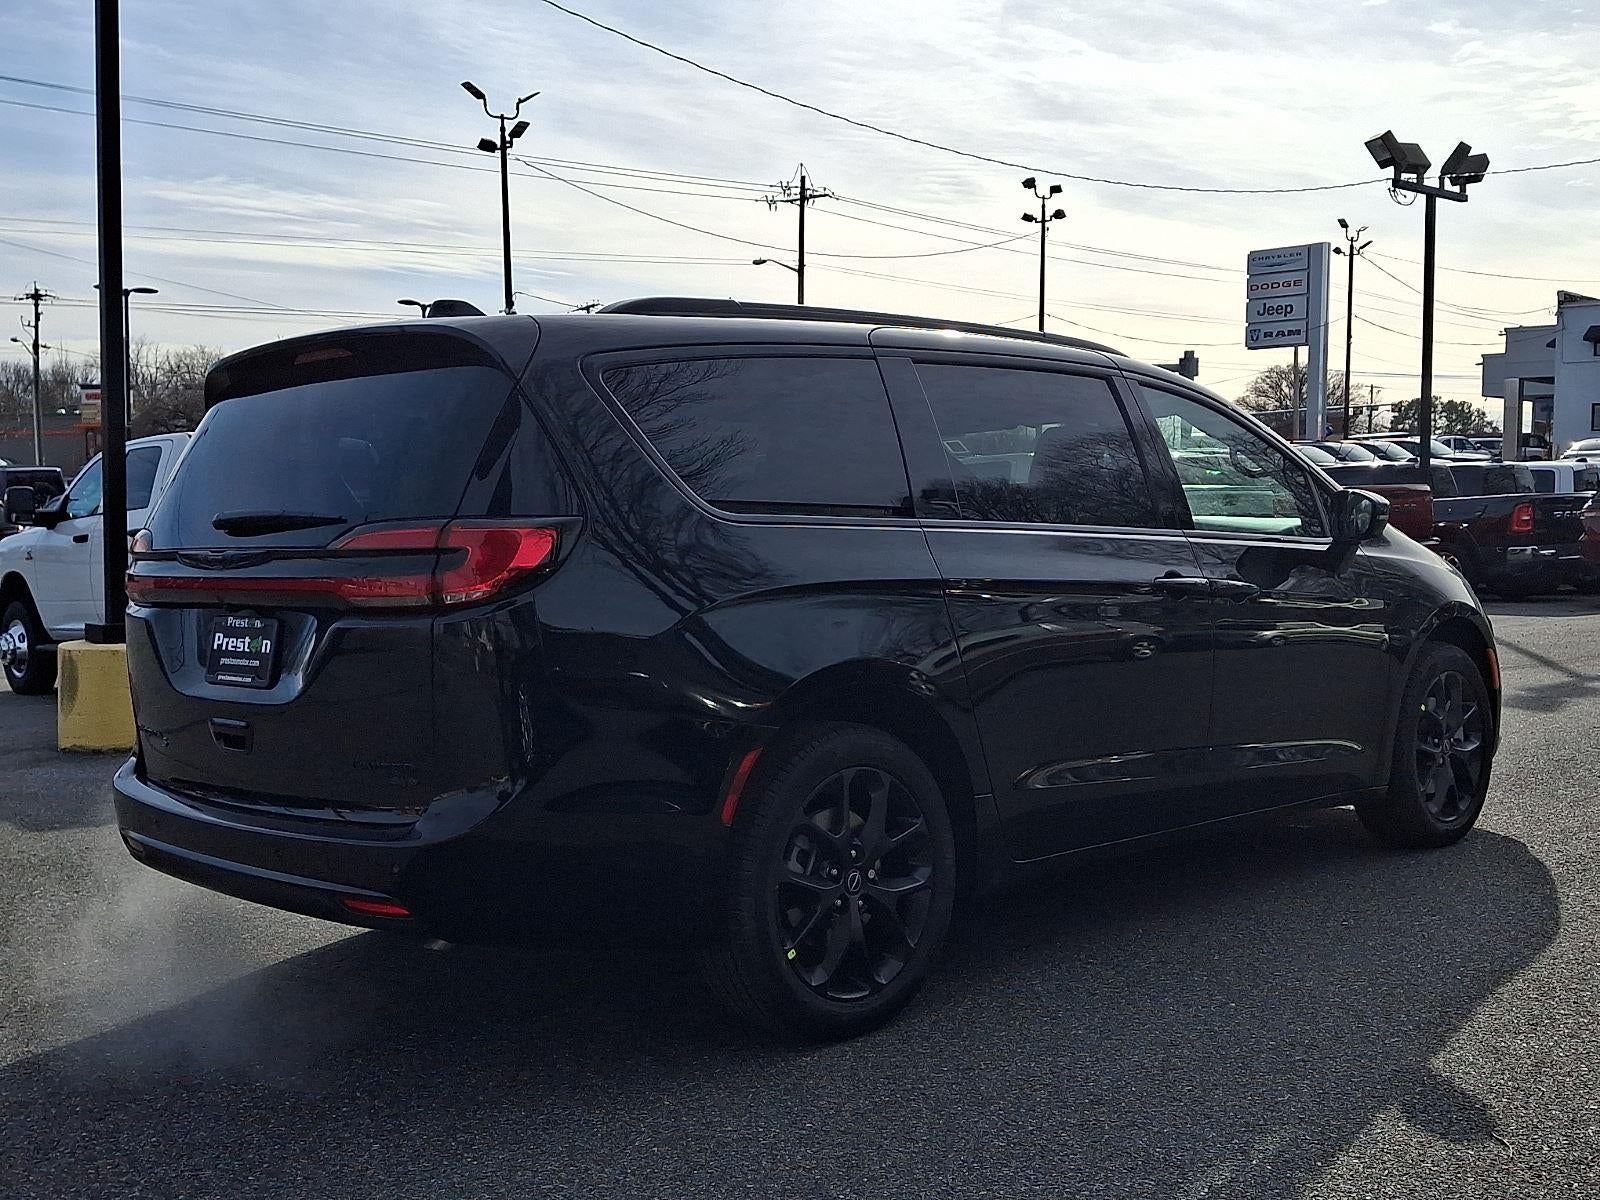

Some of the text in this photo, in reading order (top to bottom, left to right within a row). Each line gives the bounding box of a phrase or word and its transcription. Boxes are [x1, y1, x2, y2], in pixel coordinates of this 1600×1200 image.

[1252, 252, 1302, 262] CHRYSLER
[1250, 280, 1303, 291] DODGE
[1257, 303, 1294, 317] Jeep
[1263, 329, 1301, 338] RAM
[227, 617, 261, 628] Preston
[213, 633, 271, 653] Preston
